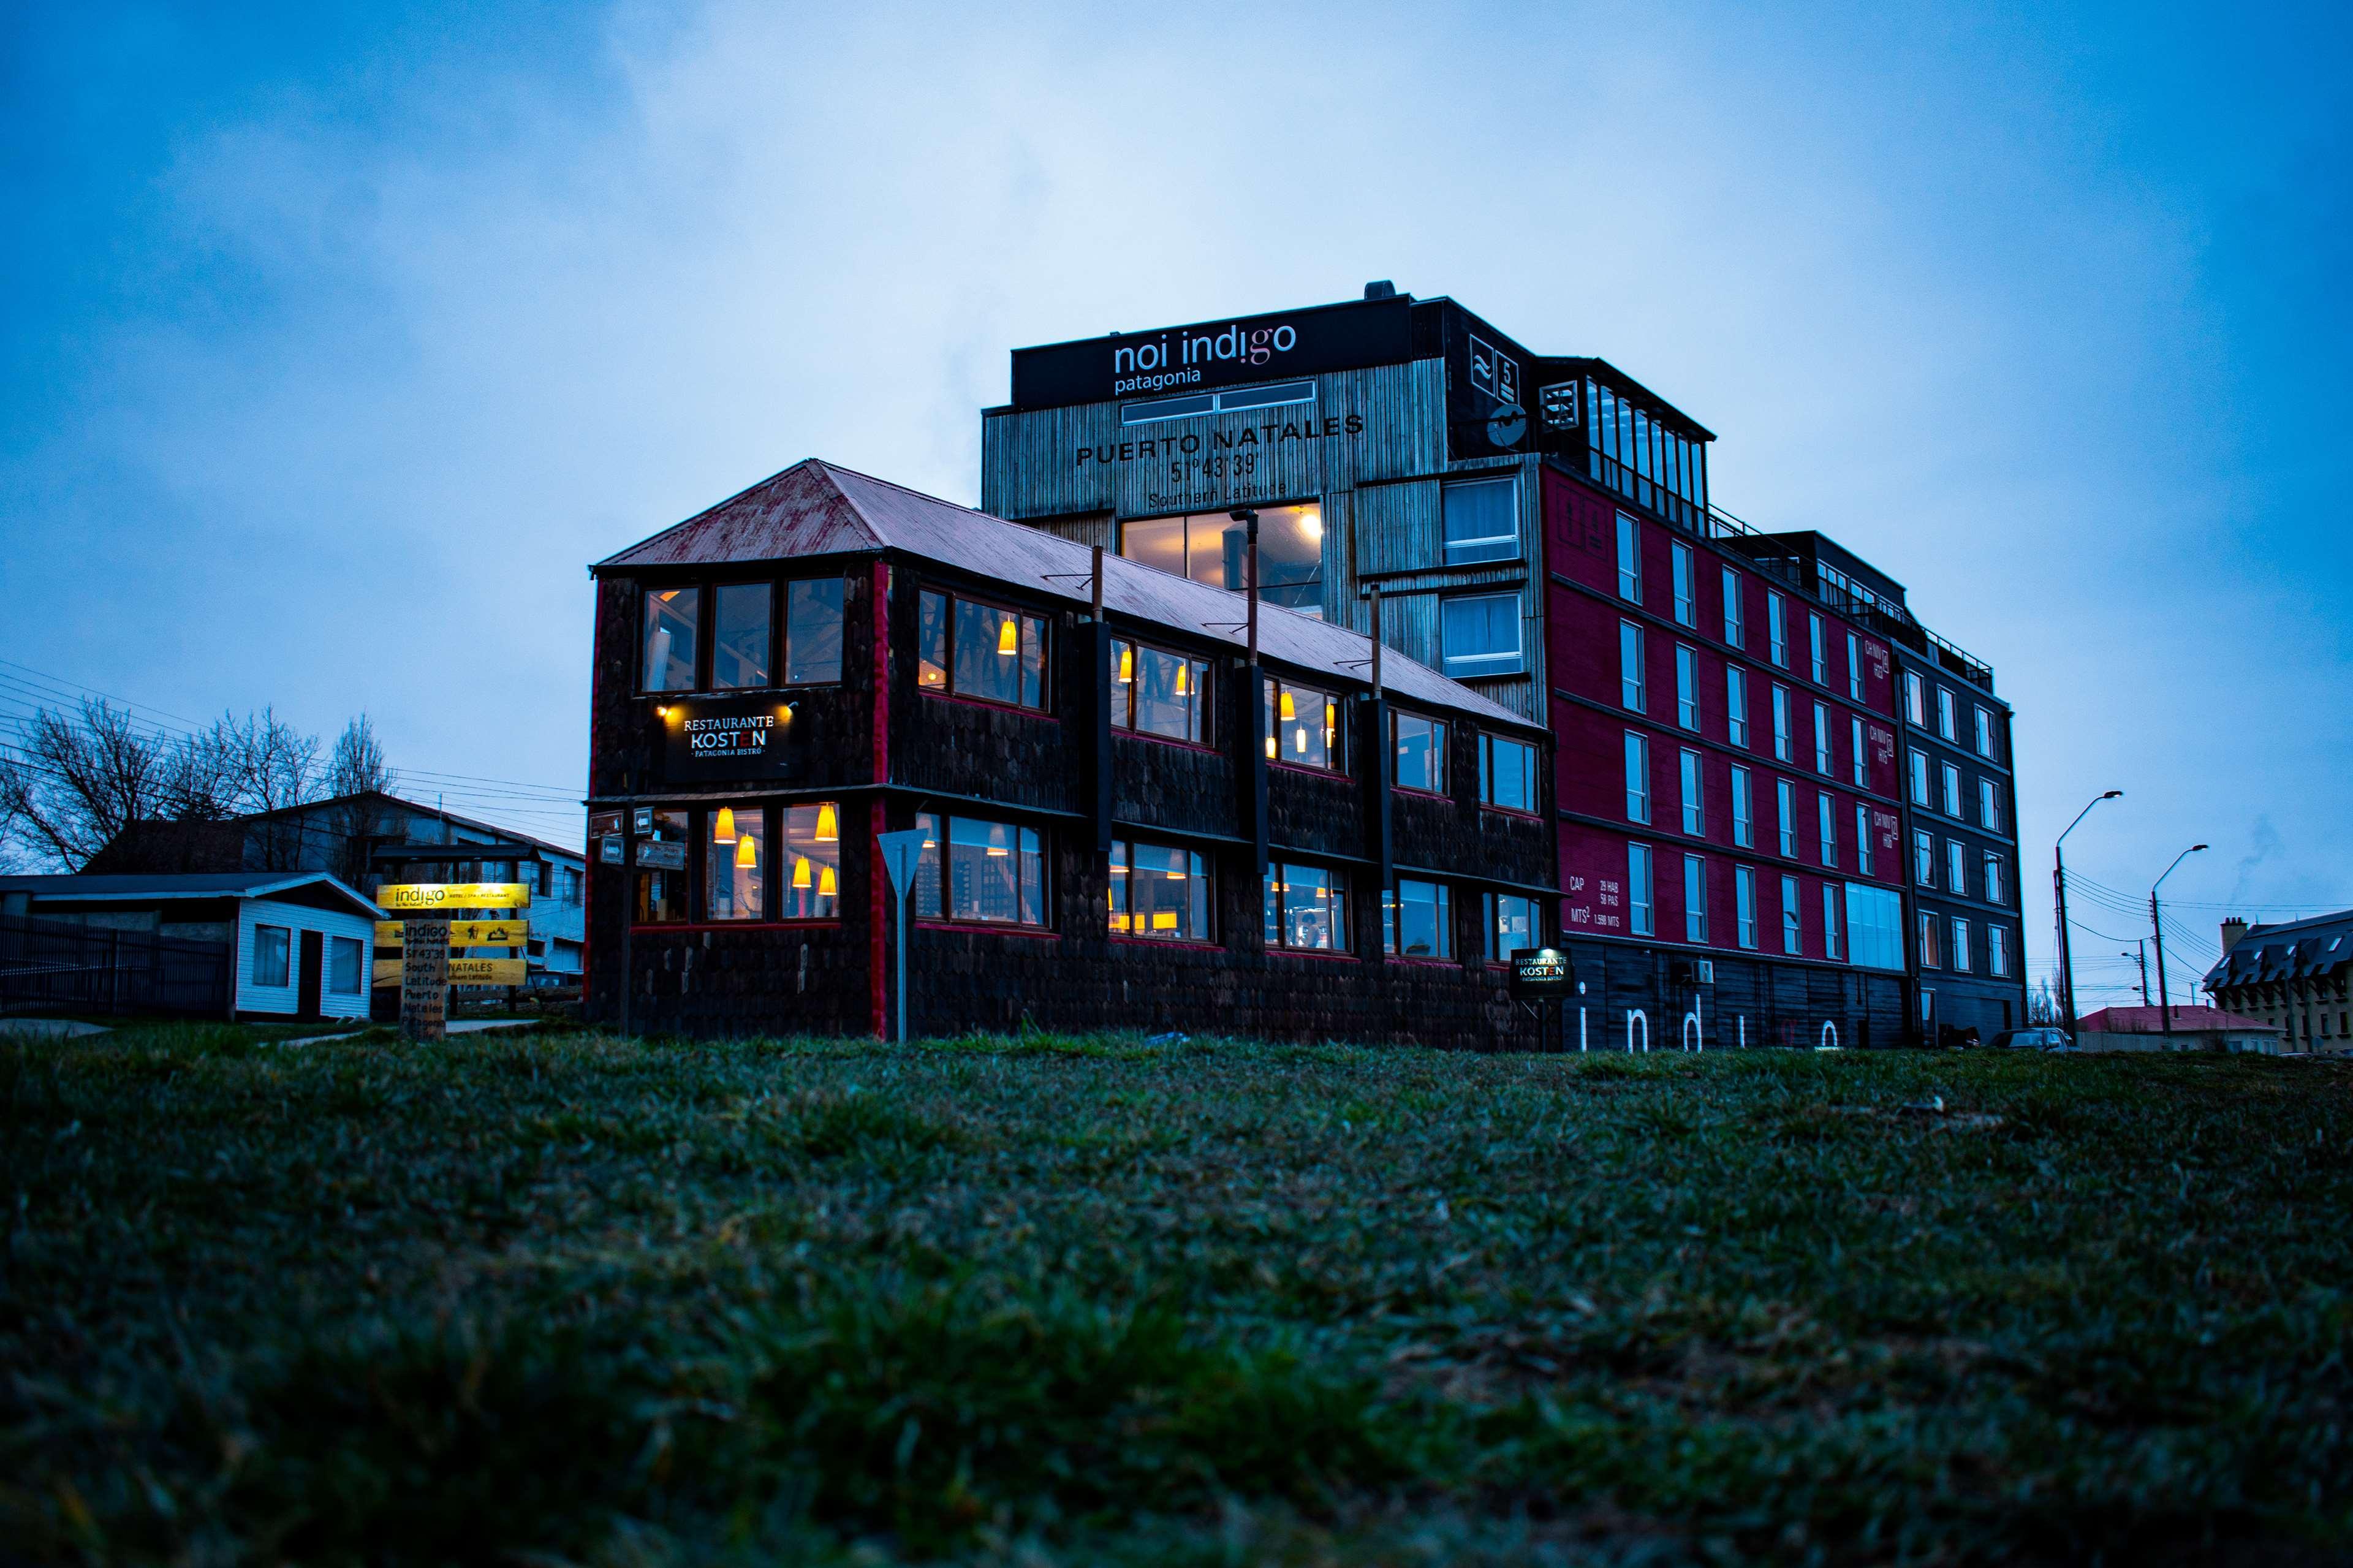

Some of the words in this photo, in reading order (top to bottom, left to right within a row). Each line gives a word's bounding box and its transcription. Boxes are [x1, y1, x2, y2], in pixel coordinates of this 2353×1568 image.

[1115, 334, 1167, 374] noi
[1182, 324, 1297, 365] indigo
[1115, 367, 1202, 396] patagonia
[1077, 434, 1200, 466] PUERTO
[1213, 414, 1363, 450] NATALES
[1149, 488, 1218, 508] Southern
[1225, 483, 1287, 501] Latitude
[684, 715, 775, 732] RESTAURANTE
[691, 730, 767, 749] KOSTEN
[695, 749, 735, 757] PATAGONIA
[1569, 876, 1584, 891] CAP
[395, 887, 445, 906] indigo
[406, 962, 436, 972] South
[449, 963, 493, 972] NATALES
[1515, 956, 1567, 966] RESTAURANTE
[1520, 966, 1564, 976] KOSTEN
[406, 976, 447, 986] Latitude
[405, 988, 439, 999] Puerto
